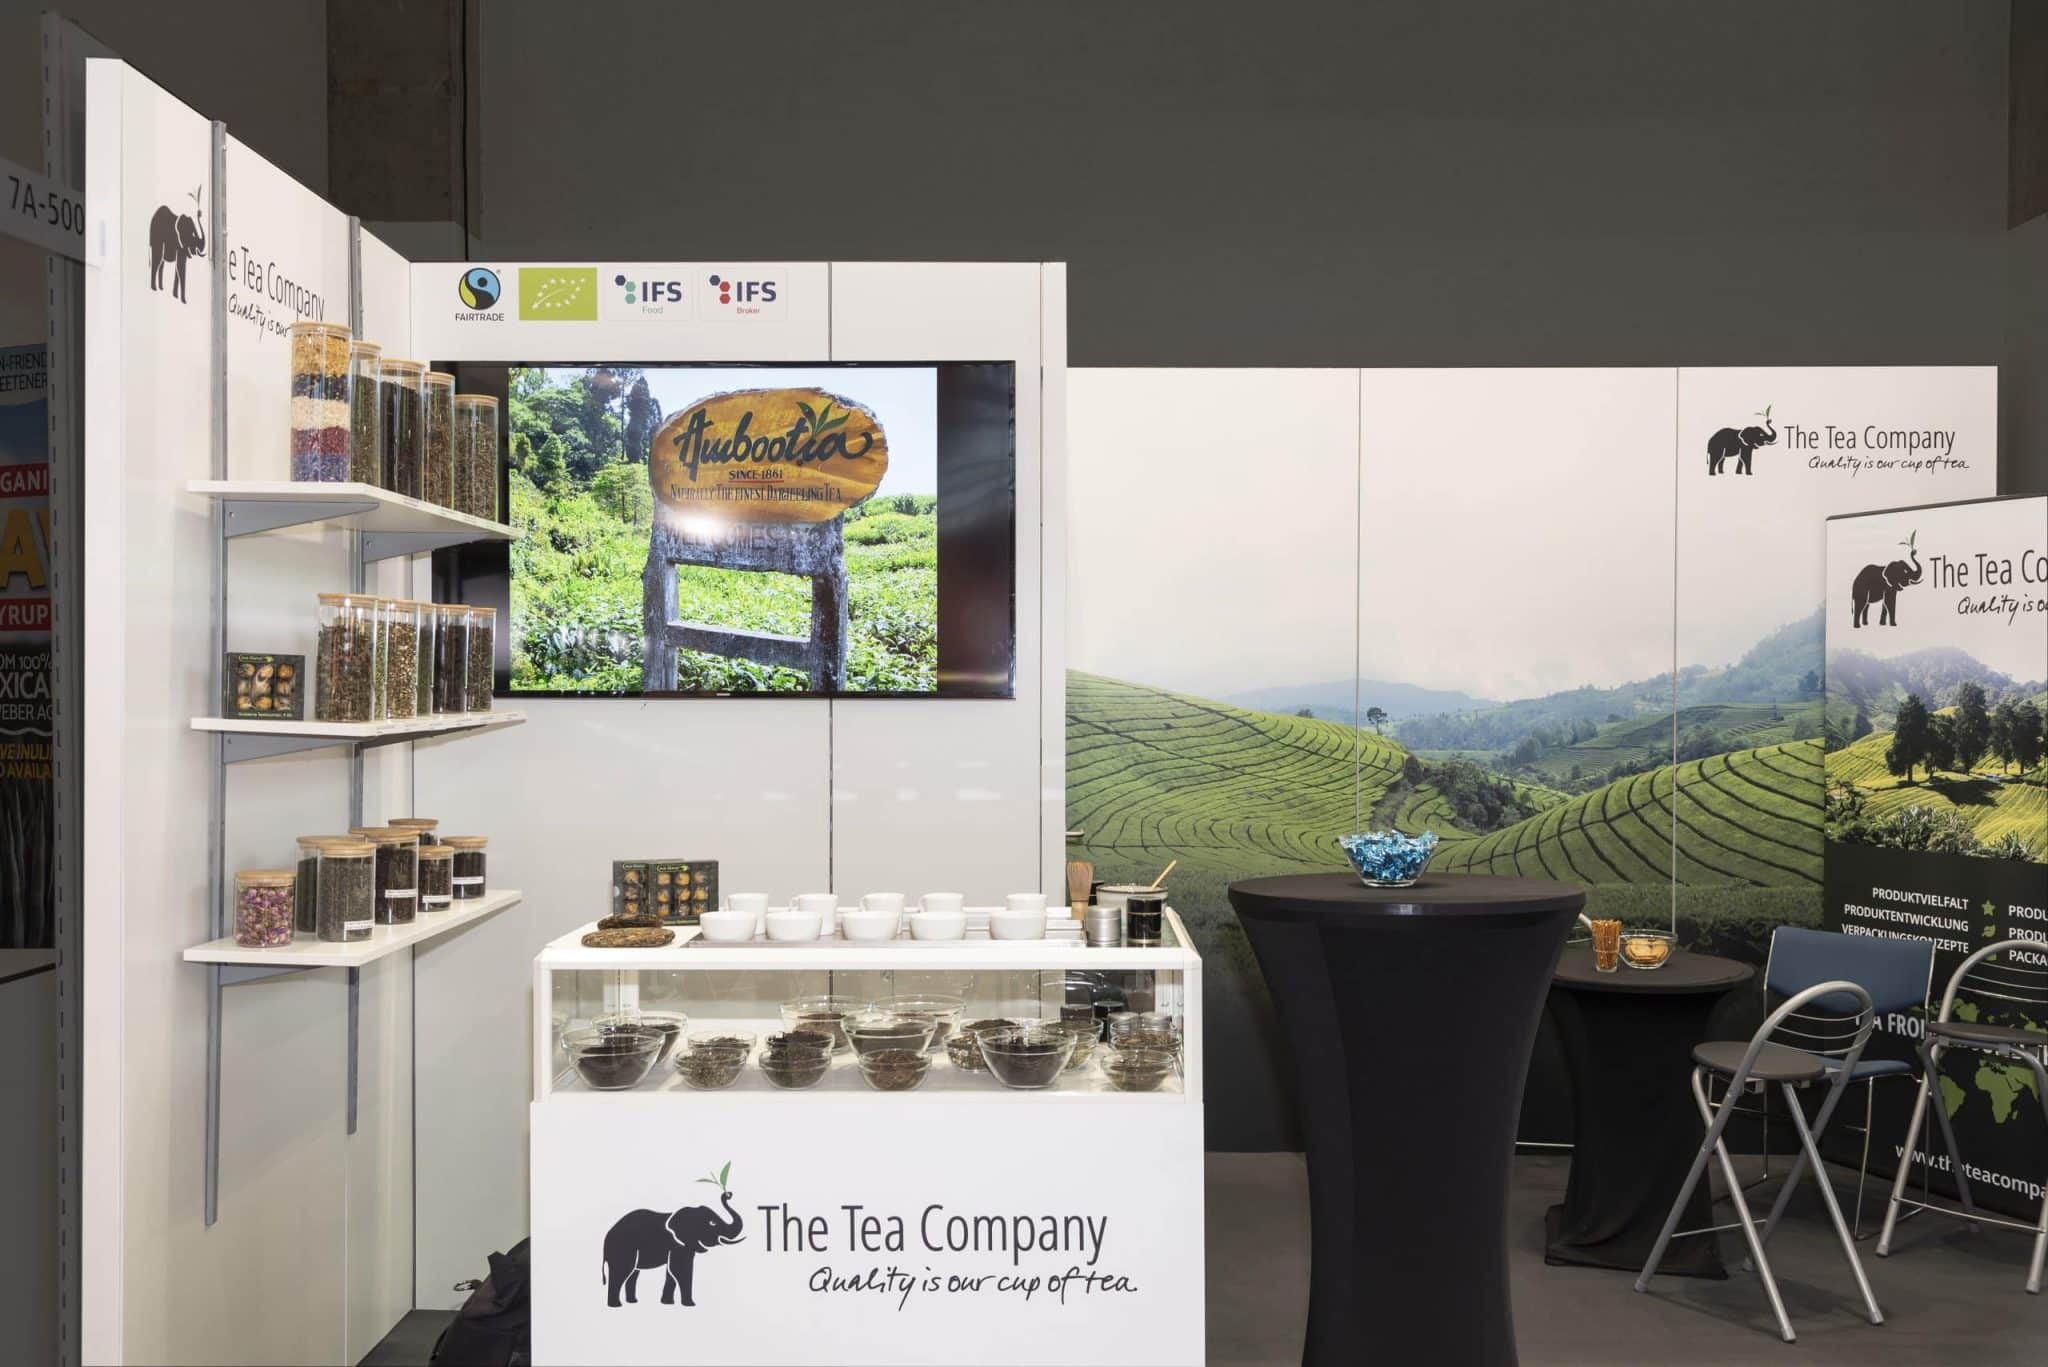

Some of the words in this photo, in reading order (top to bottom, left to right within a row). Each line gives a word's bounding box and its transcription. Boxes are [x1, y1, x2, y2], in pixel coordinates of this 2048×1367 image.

[8, 175, 85, 235] 7A-500
[241, 246, 263, 293] Tea
[267, 262, 325, 321] Company
[642, 281, 682, 302] IFS
[736, 281, 777, 302] IFS
[229, 293, 266, 343] Quality
[267, 310, 275, 332] is
[455, 313, 505, 322] FAIRTRADE
[642, 306, 664, 314] Food
[673, 406, 873, 482] Ambootia
[1783, 425, 1820, 449] The
[1825, 426, 1856, 449] Tea
[1864, 425, 1956, 457] Company
[1808, 456, 1861, 478] Quality
[1863, 456, 1874, 469] is
[1877, 459, 1900, 469] our
[1900, 460, 1923, 473] cup
[1925, 455, 1946, 475] of
[1929, 554, 1968, 589] The
[1975, 553, 2012, 586] Tea
[2021, 549, 2048, 584] Co
[1957, 594, 2020, 626] Quality
[2022, 593, 2035, 612] is
[1872, 887, 1969, 910] PRODUKTVIELFALT
[1844, 903, 1969, 932] PRODUKTENTWICKLUNG
[758, 1202, 829, 1252] The
[841, 1205, 904, 1252] Tea
[921, 1204, 1108, 1266] Company
[809, 1266, 916, 1311] Quality
[922, 1267, 942, 1292] is
[947, 1275, 996, 1292] our
[997, 1274, 1041, 1301] cup
[1048, 1266, 1088, 1304] of
